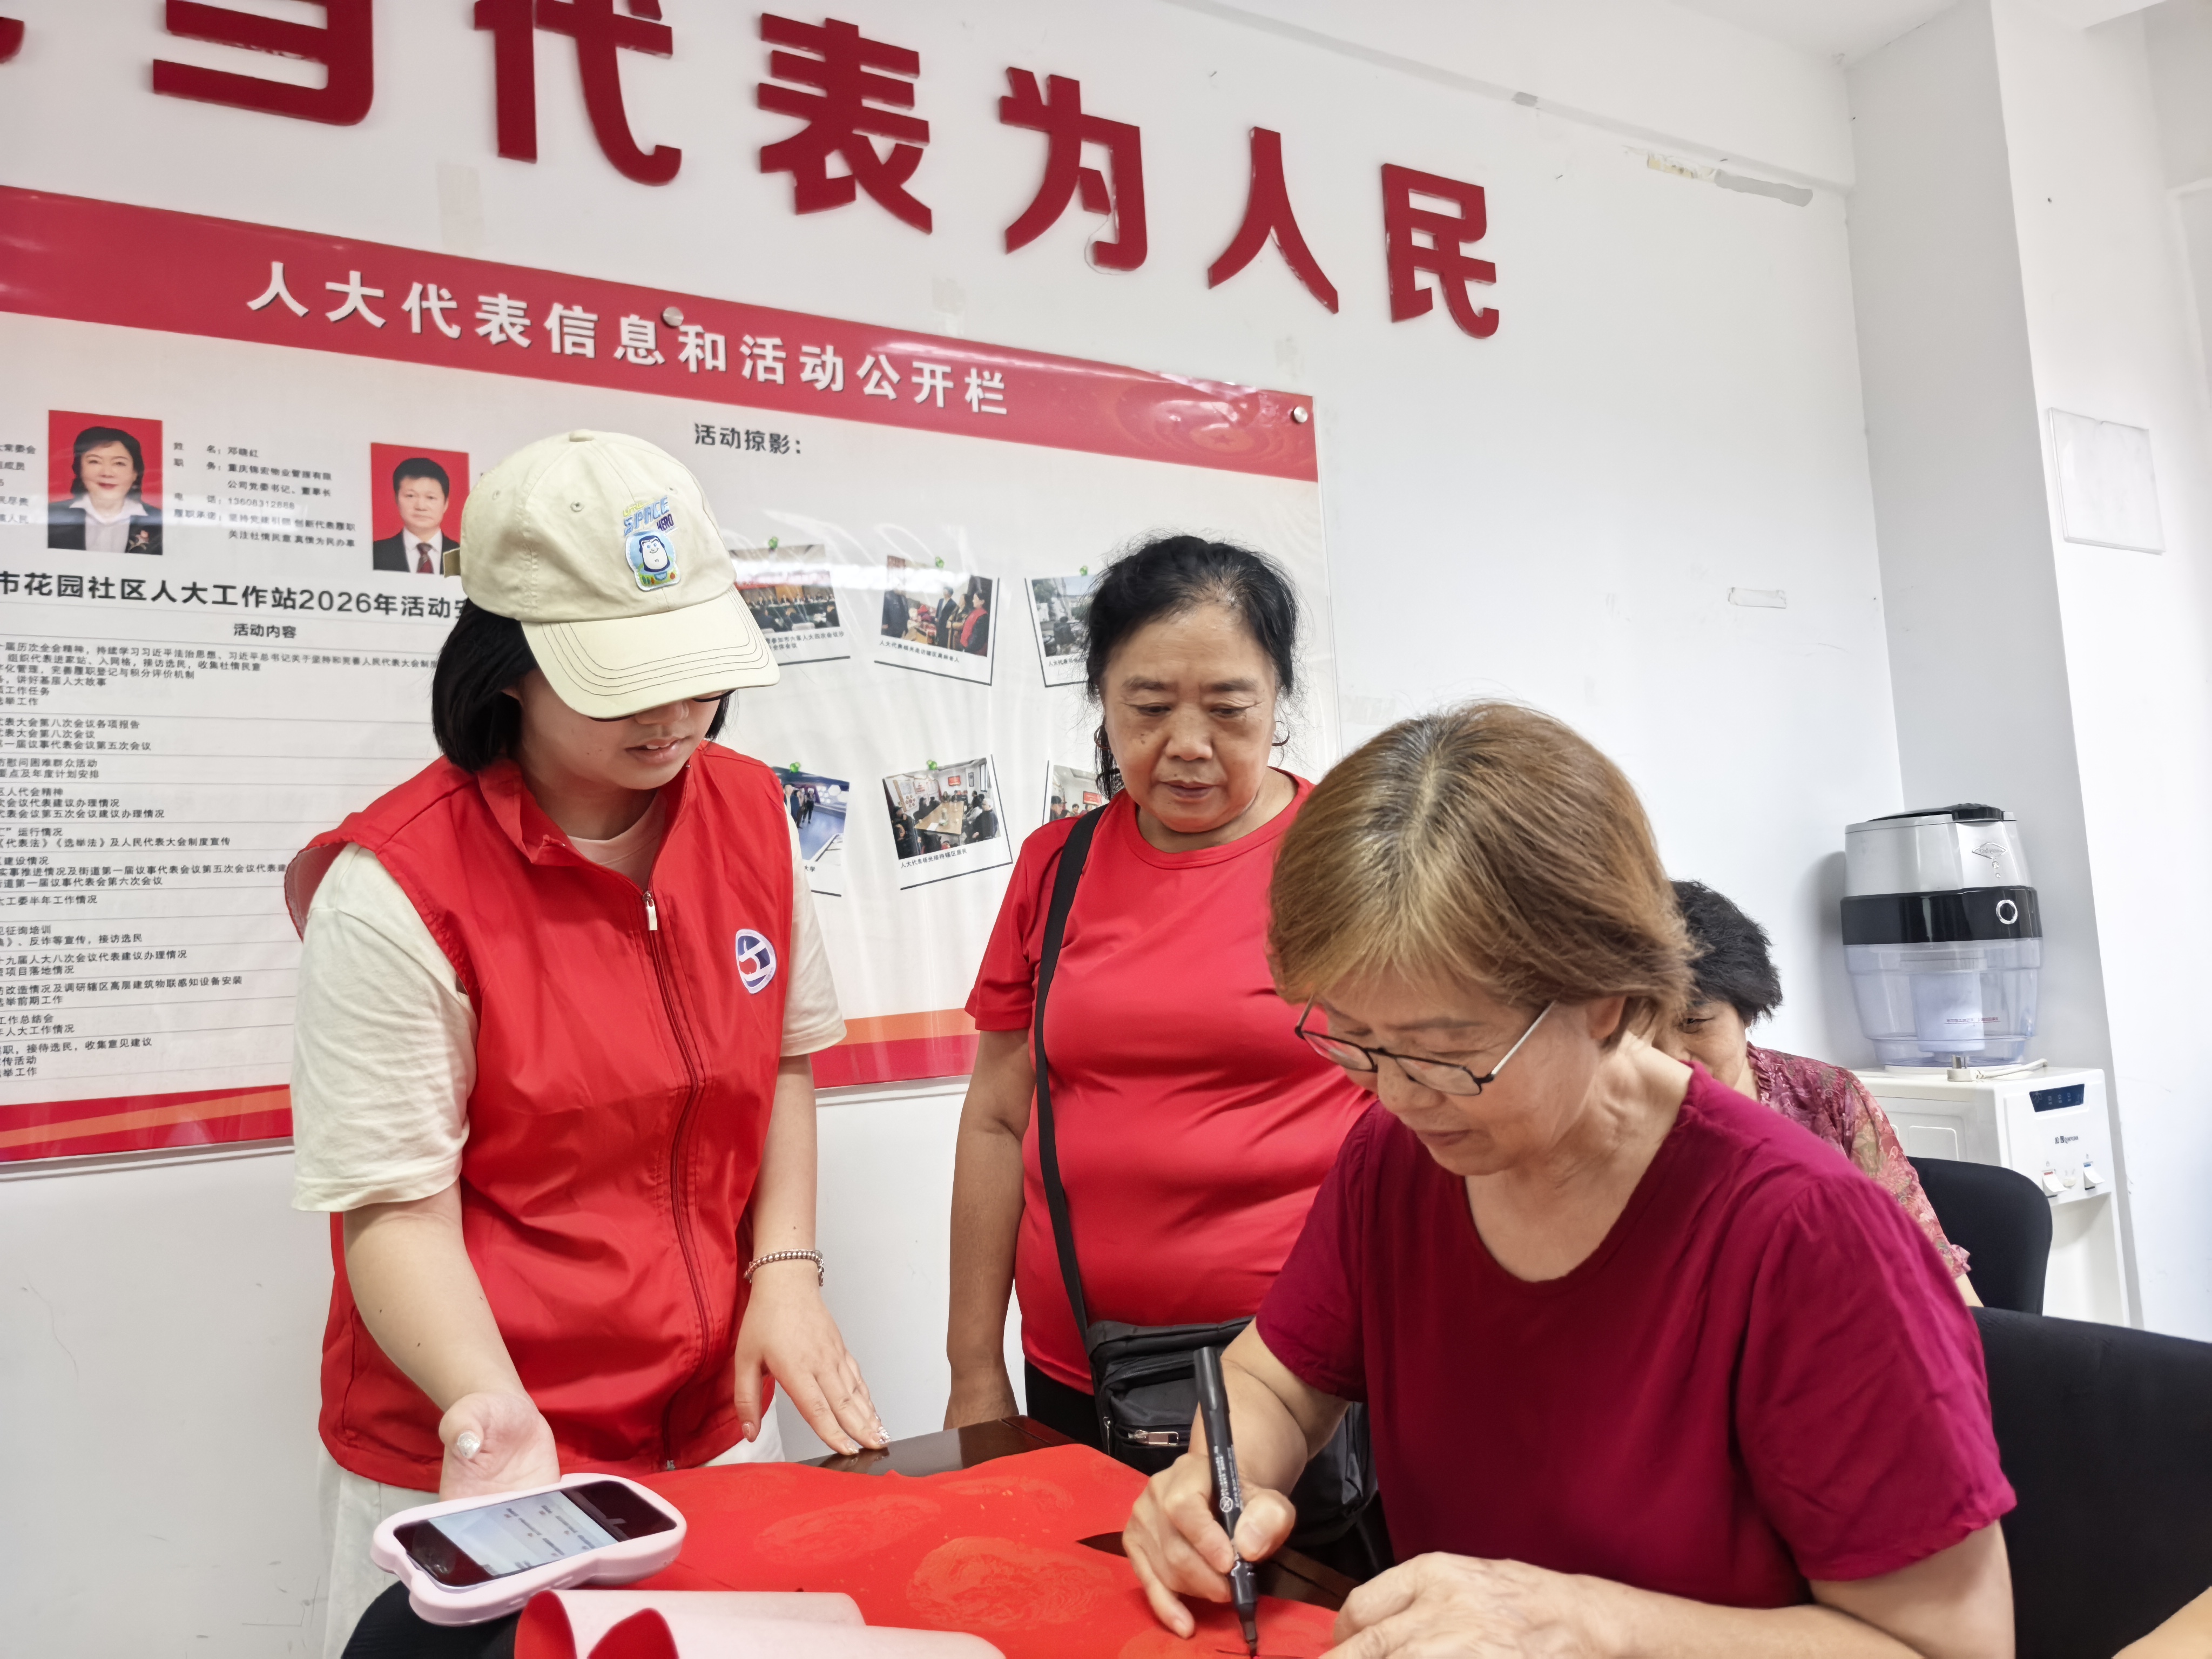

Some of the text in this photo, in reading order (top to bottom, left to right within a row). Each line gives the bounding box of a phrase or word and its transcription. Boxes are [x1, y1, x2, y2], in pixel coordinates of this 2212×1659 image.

[0, 0, 1499, 339] 当代表为人民
[247, 261, 1007, 415] 人大代表信息和活动公开栏
[0, 444, 36, 454] 常委会
[623, 495, 670, 537] SPACE
[657, 513, 674, 531] HERO
[234, 623, 296, 639] 活动内容
[0, 739, 151, 751] 一届议事代表会议第五次会议
[0, 857, 49, 865] 建设情况
[0, 876, 163, 888] 道第一届议事代表会第六次会议
[0, 1037, 152, 1055] 职，接待选民，收集意见建议
[0, 1055, 37, 1067] 传活动
[0, 1067, 37, 1078] 举工作
